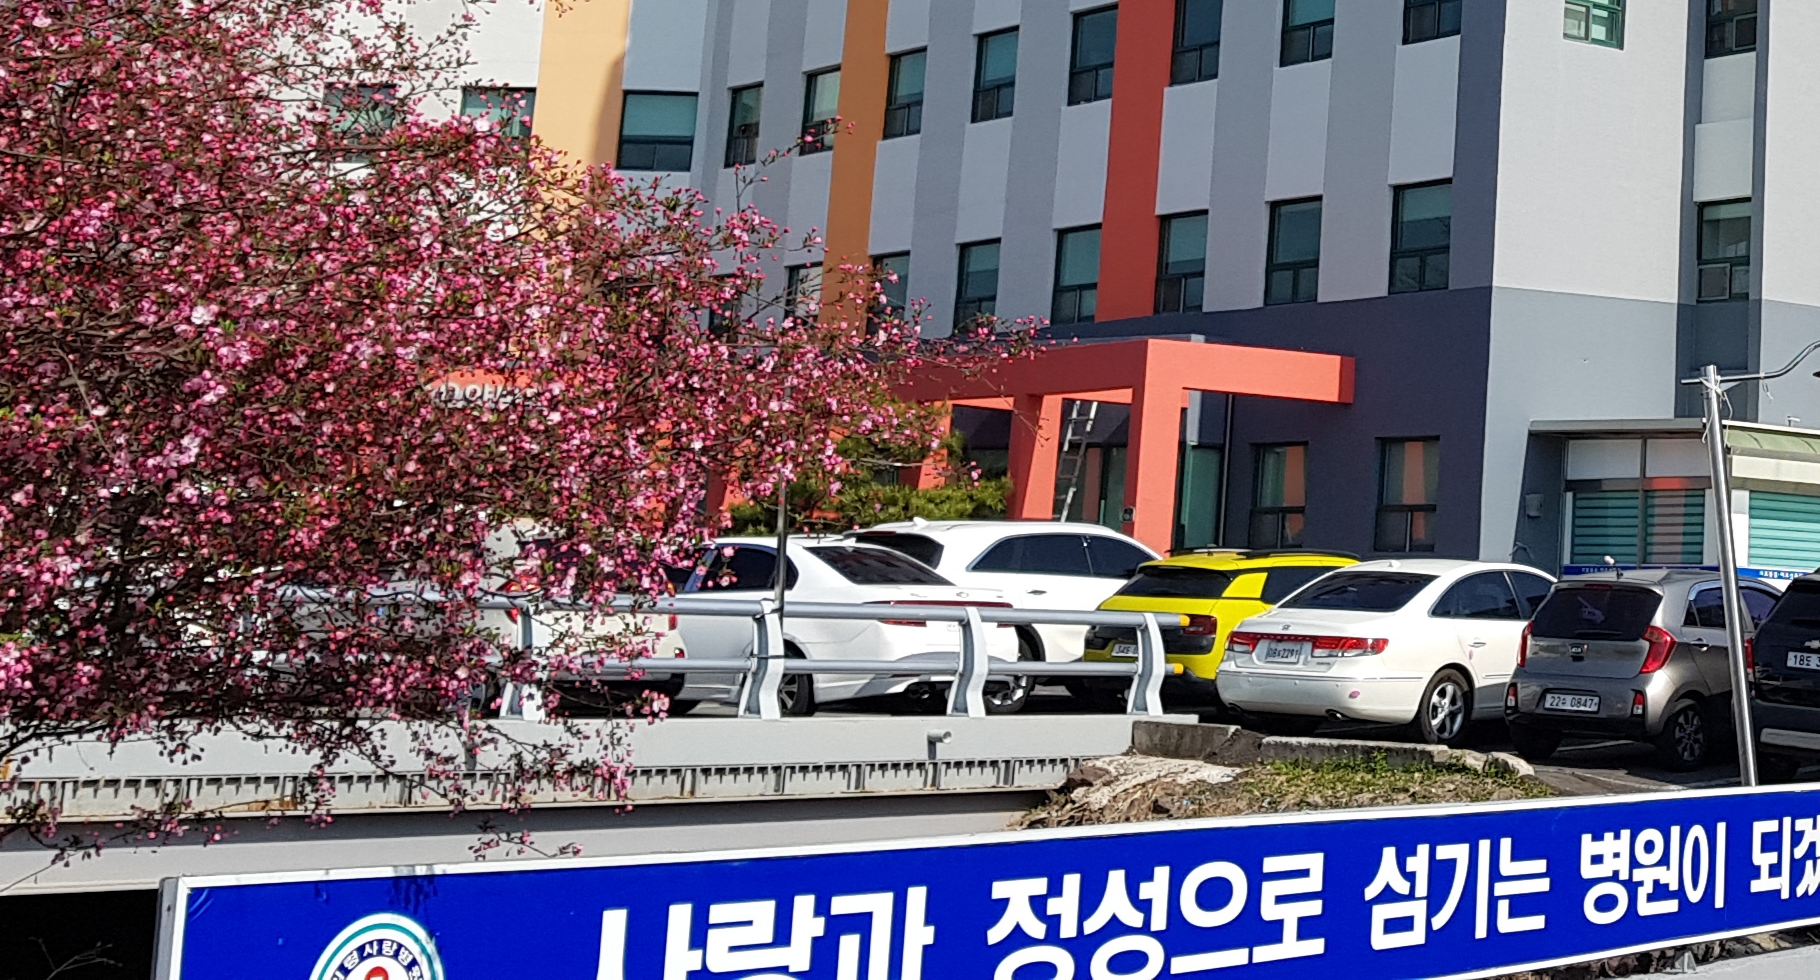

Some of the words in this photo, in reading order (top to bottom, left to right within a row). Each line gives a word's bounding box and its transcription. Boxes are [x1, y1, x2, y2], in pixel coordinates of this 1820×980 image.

[1570, 696, 1595, 709] 0847
[986, 852, 1326, 980] 정성으로
[1363, 836, 1551, 951] 섬기는
[1580, 821, 1727, 925] 병원이
